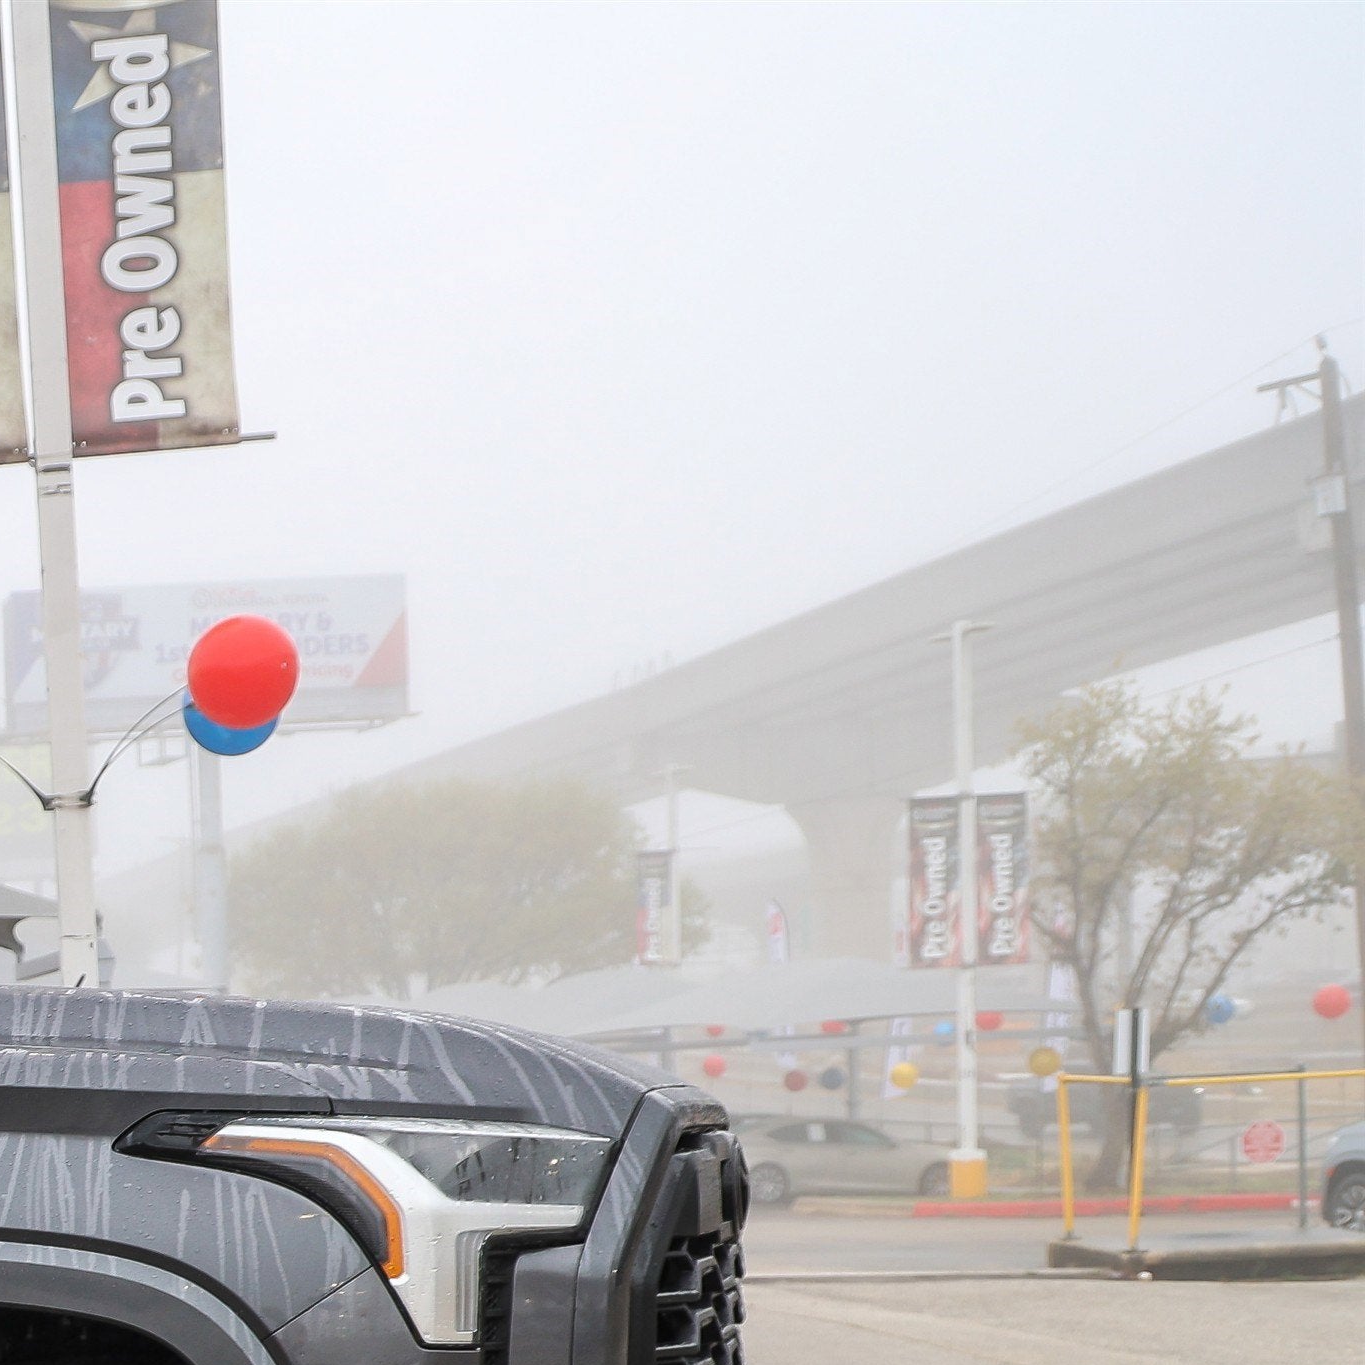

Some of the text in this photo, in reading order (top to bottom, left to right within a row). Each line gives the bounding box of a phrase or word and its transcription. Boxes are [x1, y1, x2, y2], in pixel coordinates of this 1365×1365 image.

[91, 34, 185, 423] Pre Owned
[921, 836, 948, 916] Owned
[989, 833, 1013, 913] Owned
[921, 919, 948, 959] Pre
[989, 916, 1015, 956] Pre
